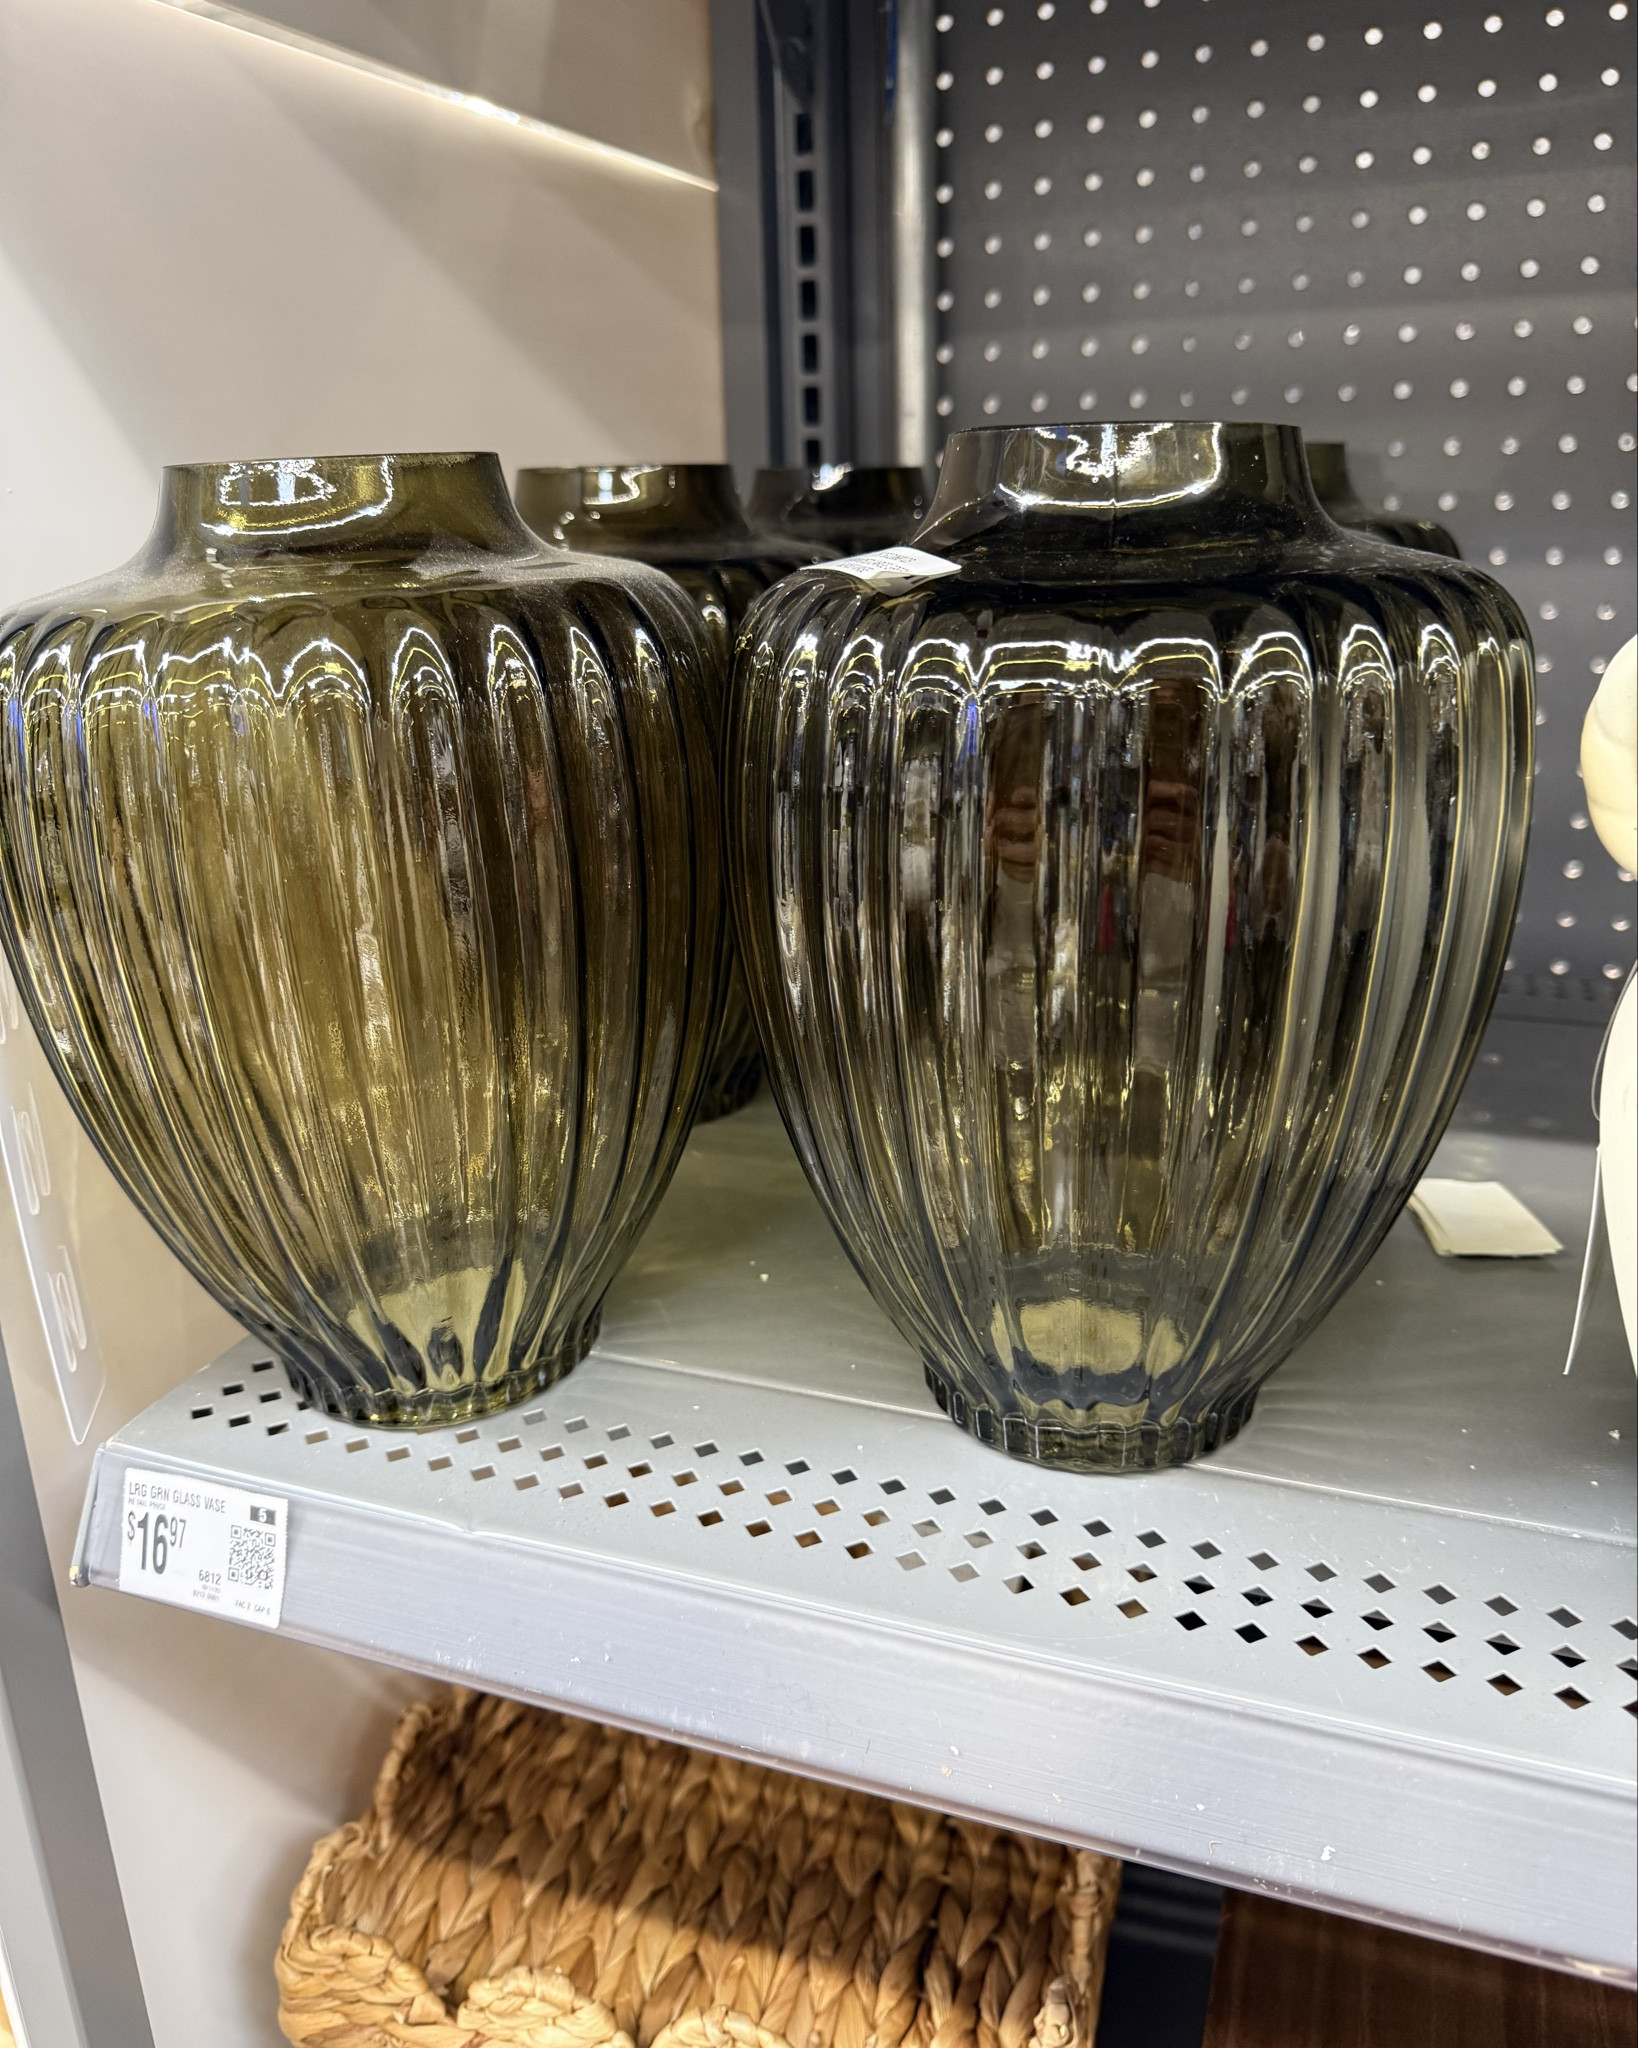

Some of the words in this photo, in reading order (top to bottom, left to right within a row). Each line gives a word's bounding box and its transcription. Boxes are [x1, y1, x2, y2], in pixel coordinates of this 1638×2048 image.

[129, 1482, 147, 1497] LRG
[150, 1485, 170, 1501] GRN
[173, 1490, 201, 1508] GLASS
[204, 1498, 226, 1514] VASE
[198, 1569, 221, 1585] 6812
